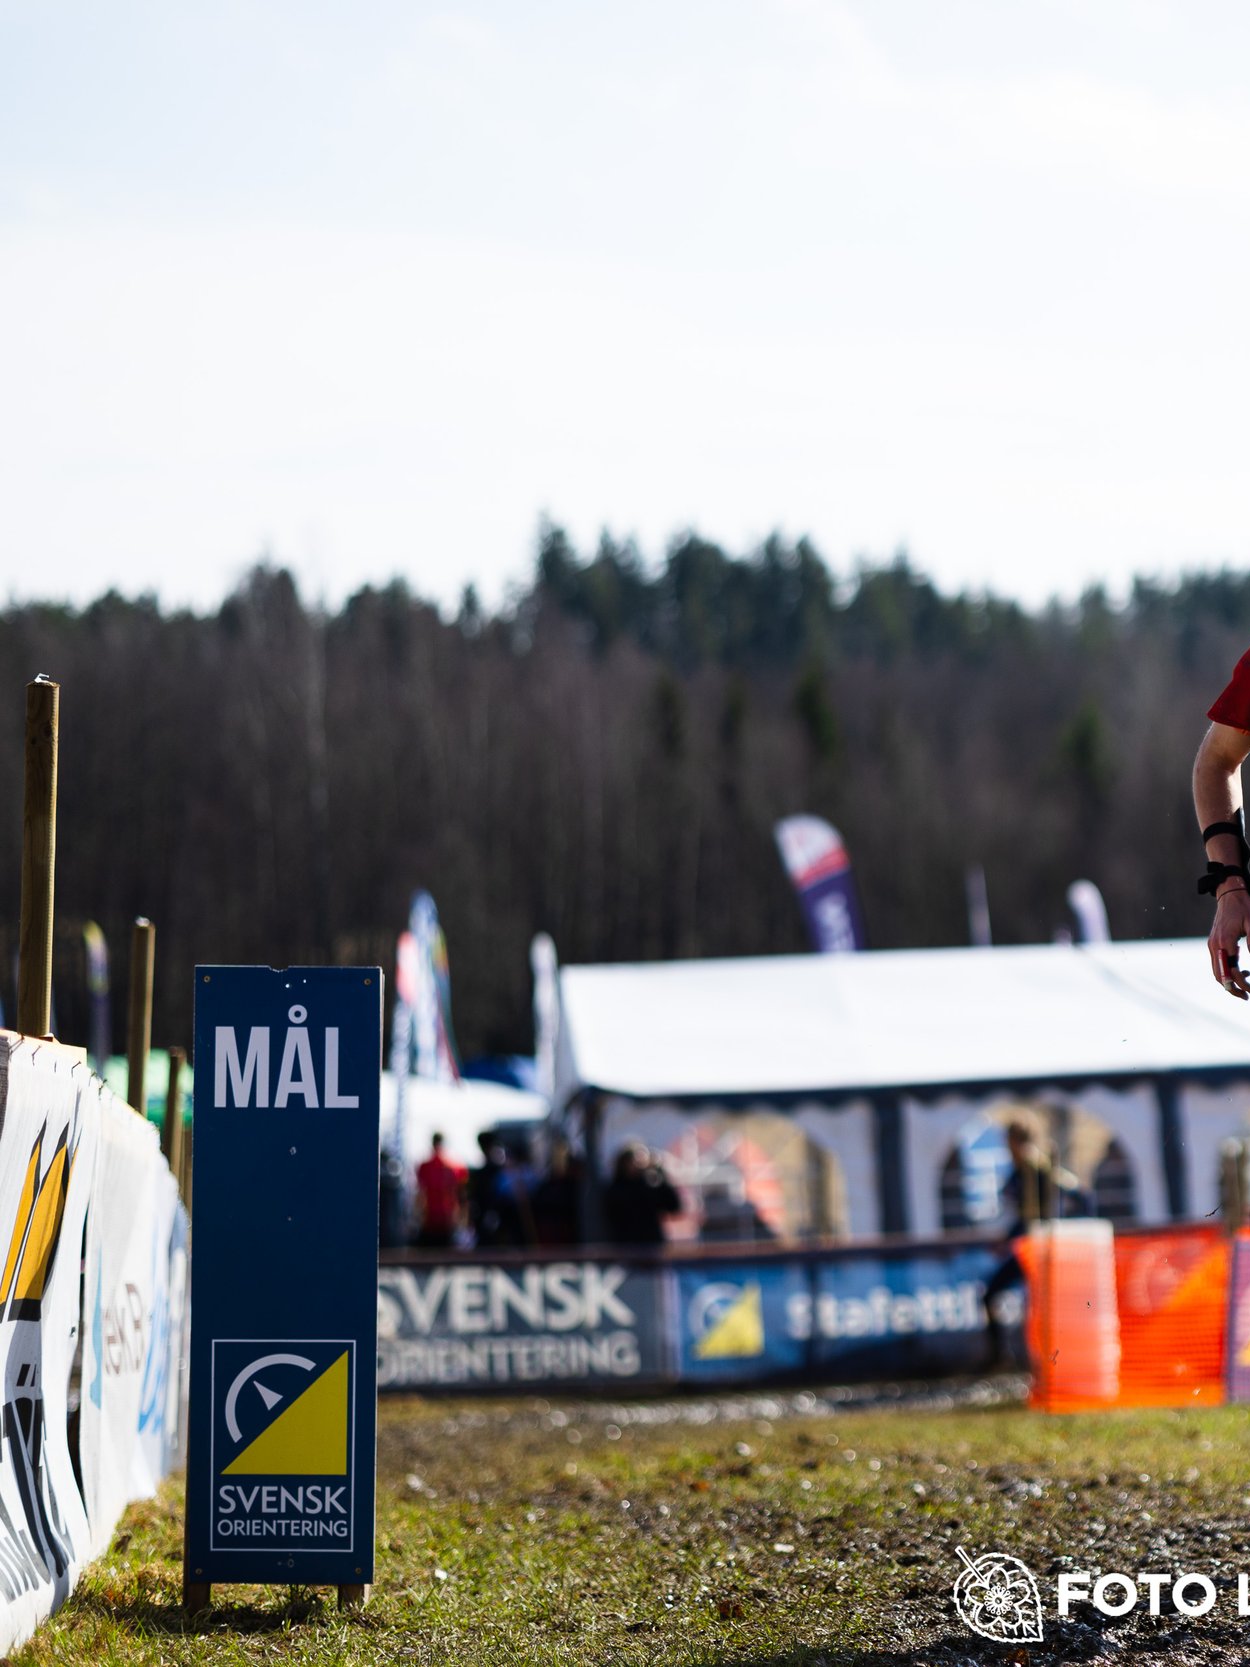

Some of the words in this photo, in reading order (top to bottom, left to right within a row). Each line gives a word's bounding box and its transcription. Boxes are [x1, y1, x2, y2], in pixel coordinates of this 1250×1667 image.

[214, 1004, 359, 1108] MÅL
[218, 1485, 348, 1514] SVENSK
[217, 1519, 348, 1537] ORIENTERING
